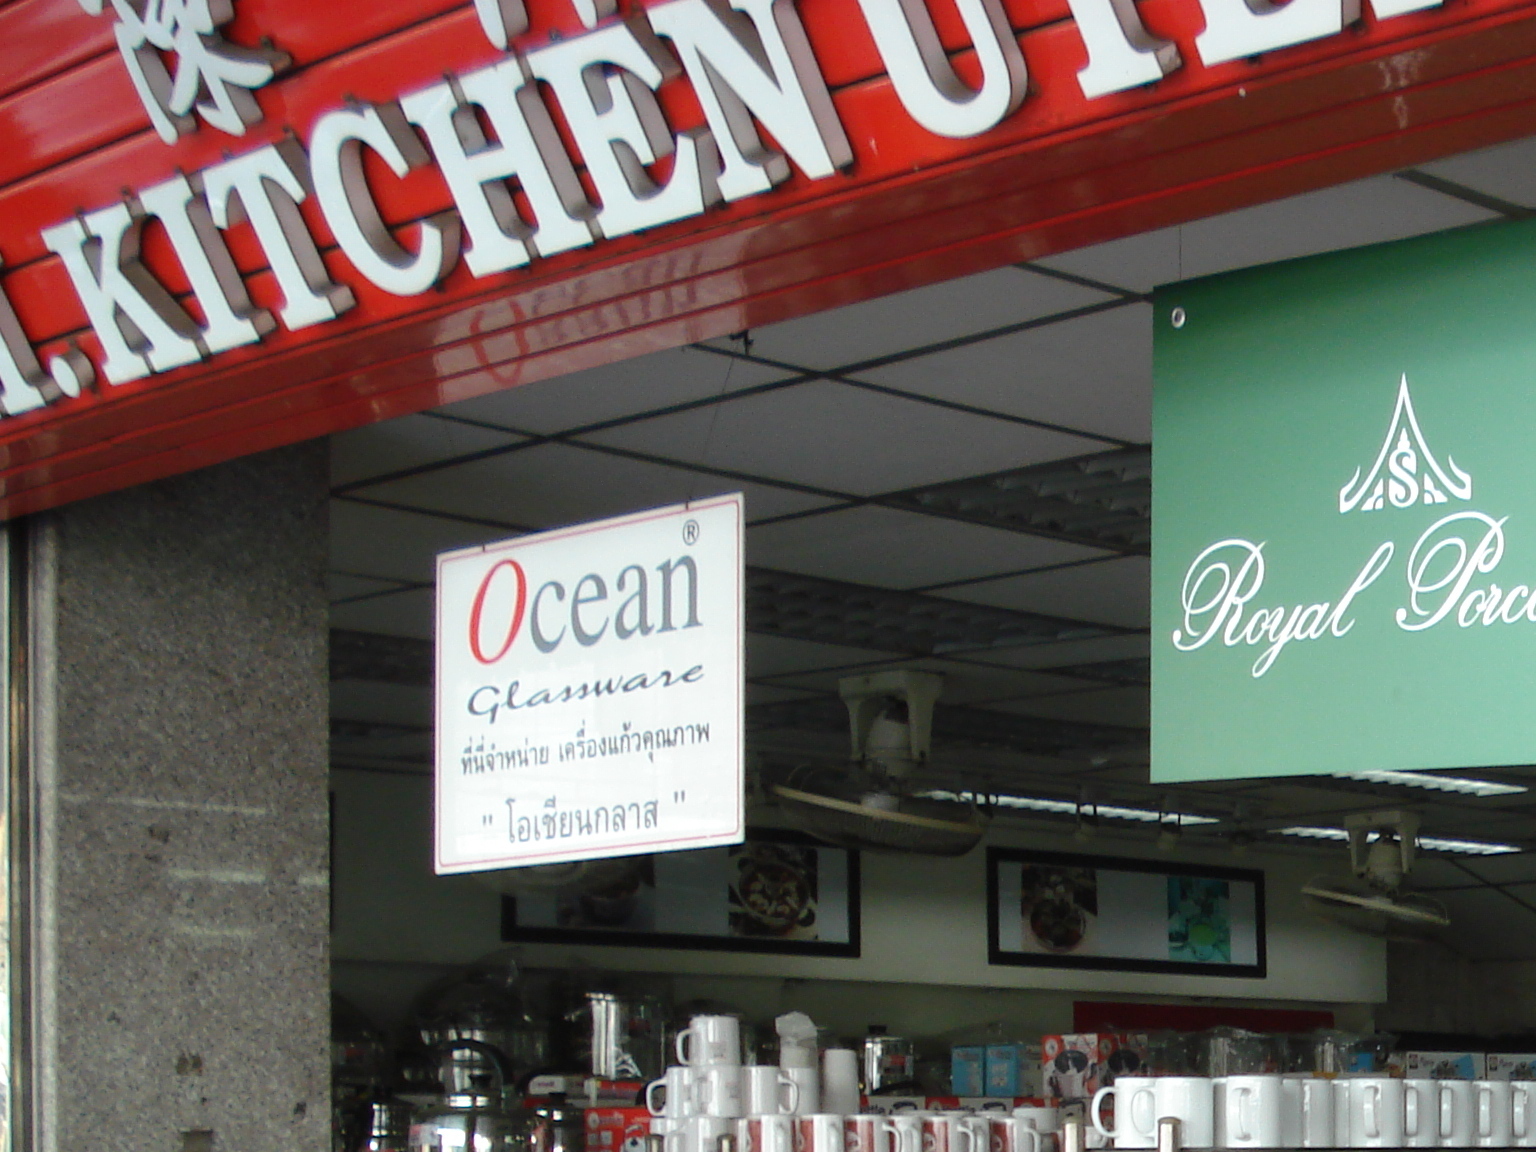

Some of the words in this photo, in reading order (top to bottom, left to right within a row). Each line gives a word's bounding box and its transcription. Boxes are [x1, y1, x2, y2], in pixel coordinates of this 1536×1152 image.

[468, 555, 704, 665] Ocean
[1172, 538, 1395, 678] Royal
[467, 663, 706, 725] Glassware
